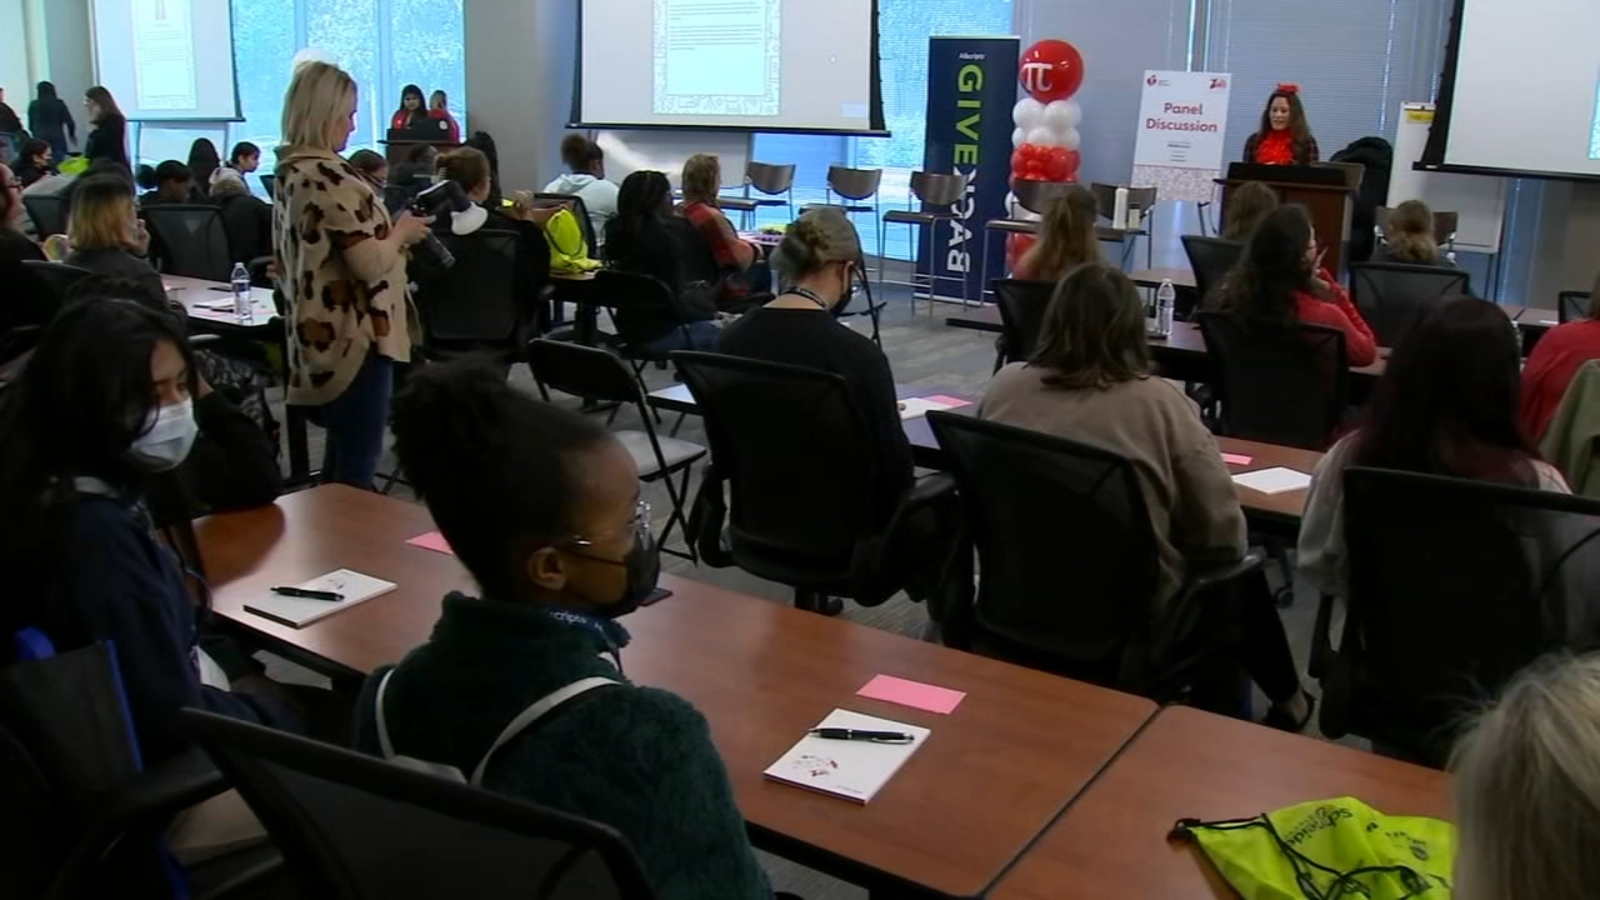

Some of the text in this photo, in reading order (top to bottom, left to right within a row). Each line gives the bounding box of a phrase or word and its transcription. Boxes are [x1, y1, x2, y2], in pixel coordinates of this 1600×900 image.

[954, 64, 983, 165] GIVE
[1163, 102, 1203, 115] Panel
[1146, 118, 1218, 132] Discussion
